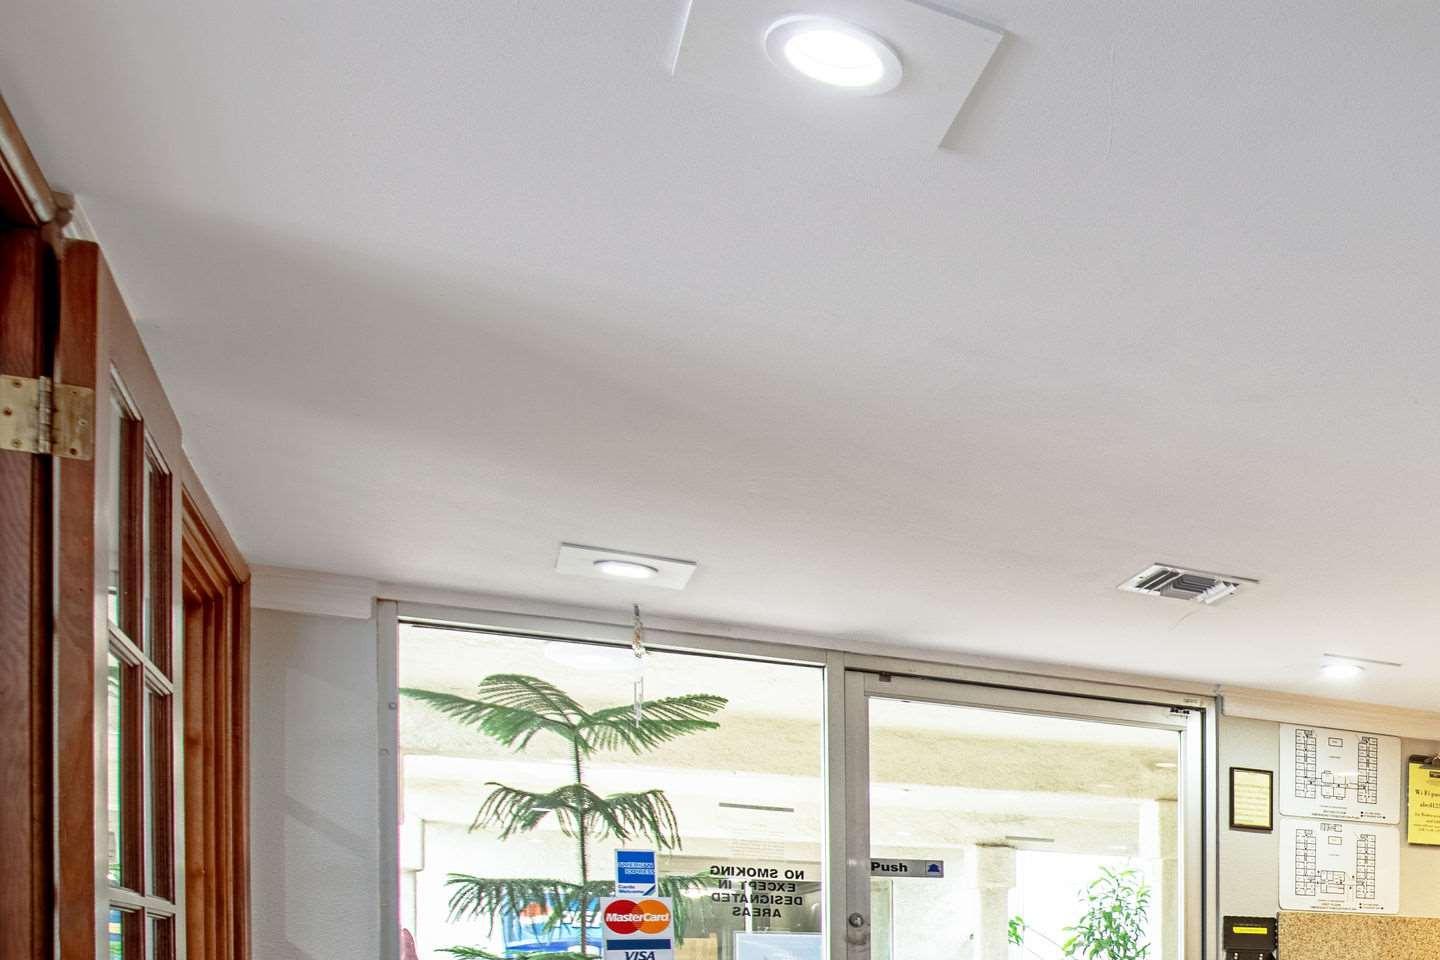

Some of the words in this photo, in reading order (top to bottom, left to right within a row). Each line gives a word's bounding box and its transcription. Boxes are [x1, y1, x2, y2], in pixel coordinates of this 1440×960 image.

[871, 861, 908, 873] Push
[606, 912, 670, 923] MasterCard
[625, 951, 656, 960] VISA
